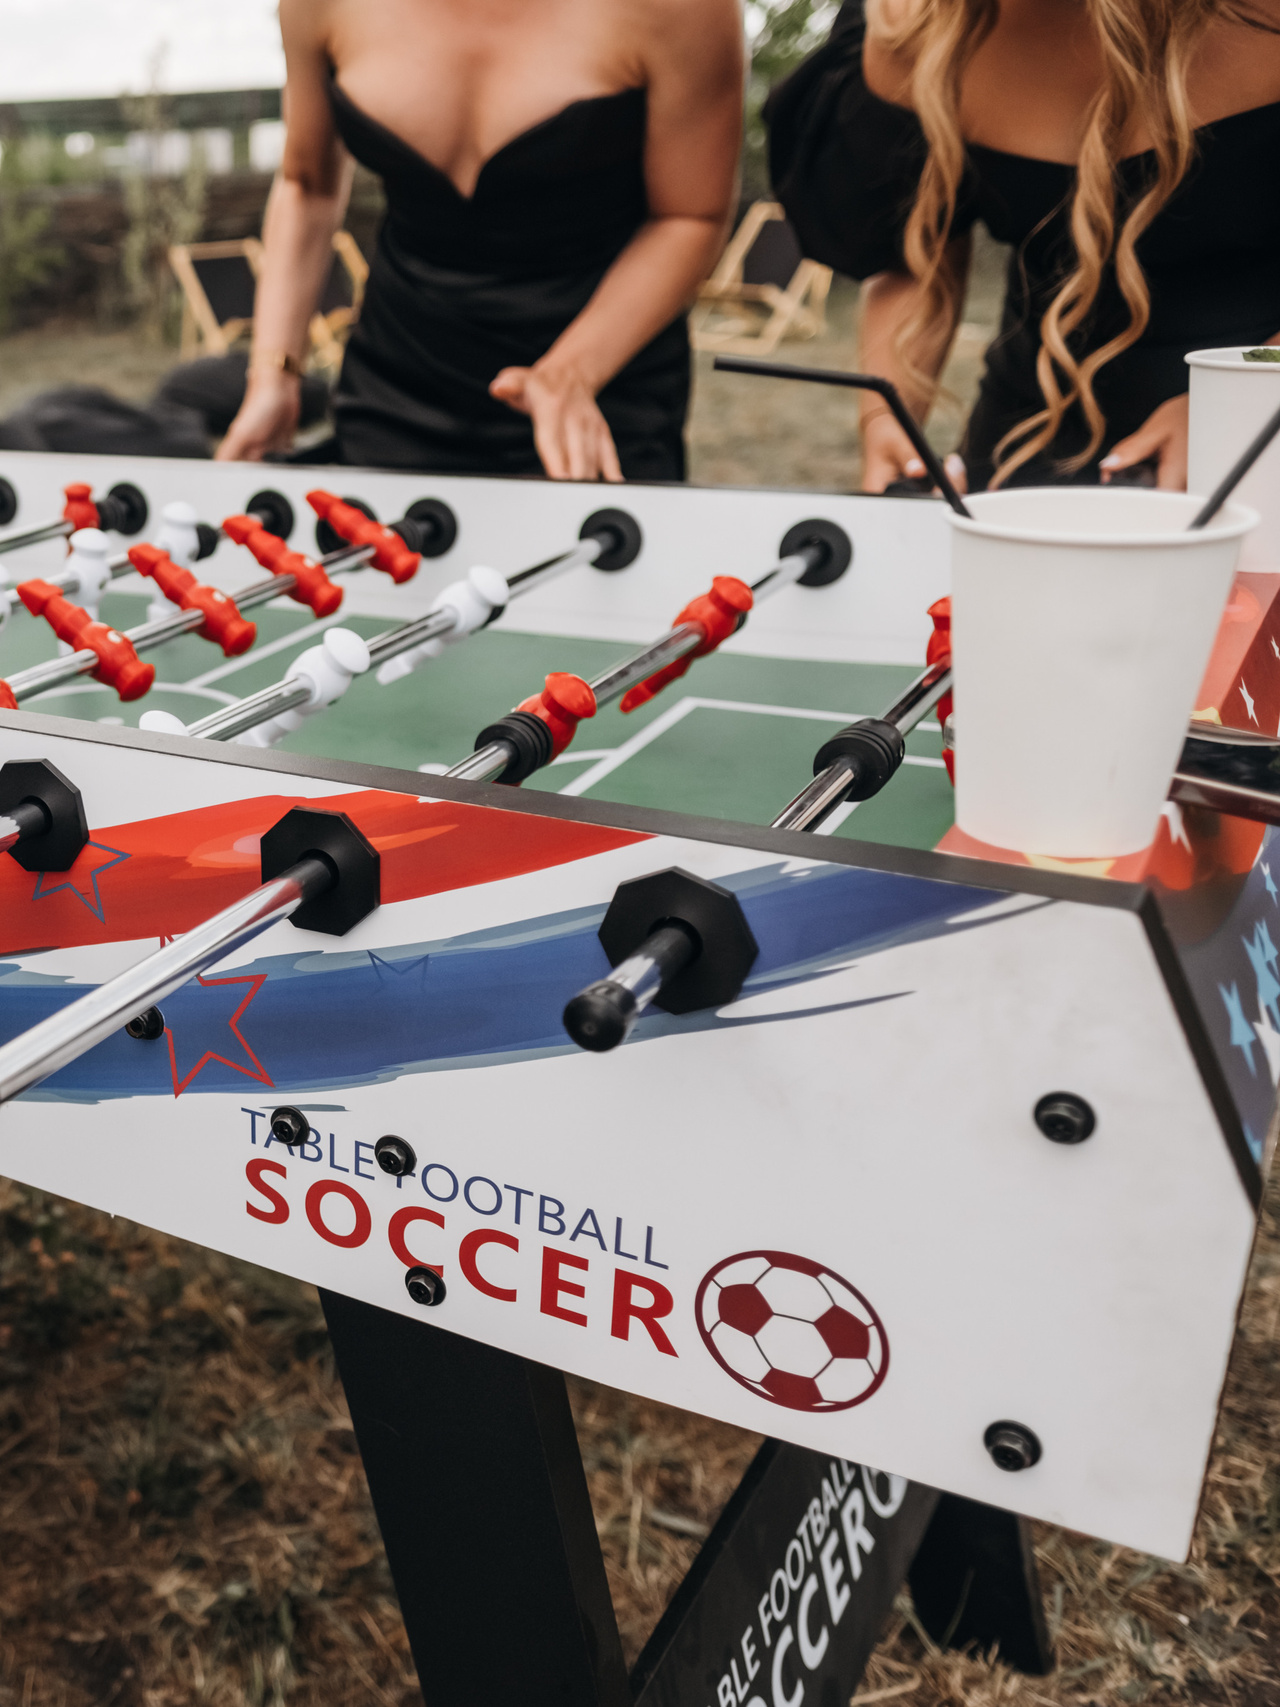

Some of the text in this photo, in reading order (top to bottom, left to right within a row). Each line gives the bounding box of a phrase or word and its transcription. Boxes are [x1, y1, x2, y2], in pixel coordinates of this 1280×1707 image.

[245, 1157, 680, 1359] SOCCER
[395, 1162, 670, 1271] OOTBALL
[705, 1458, 856, 1707] BLE FOOTBALL
[744, 1487, 876, 1707] CCER
